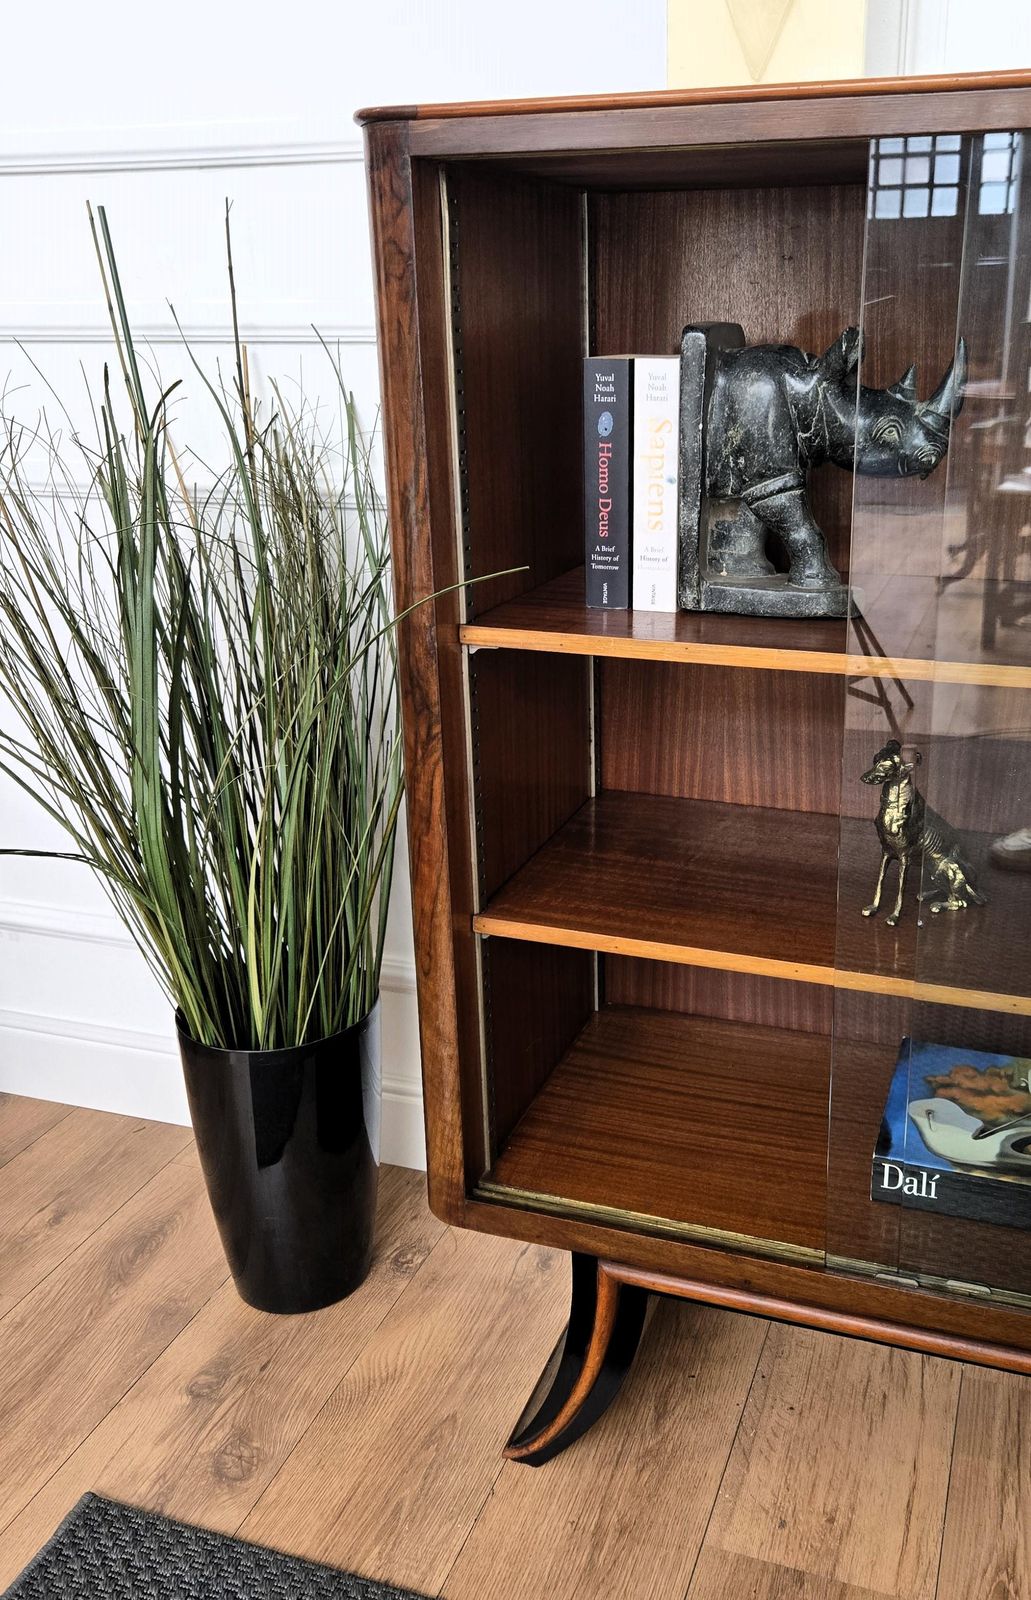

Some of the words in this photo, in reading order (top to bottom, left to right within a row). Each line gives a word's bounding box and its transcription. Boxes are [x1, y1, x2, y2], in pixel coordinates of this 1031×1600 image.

[595, 373, 615, 382] Yuval
[648, 372, 667, 381] Yuval
[595, 384, 615, 392] Noah
[648, 384, 667, 392] Noah
[593, 394, 617, 403] Harari
[598, 442, 612, 494] Homo
[640, 418, 673, 531] Sapiens
[598, 498, 612, 538] Deus
[591, 554, 612, 563] History
[640, 555, 661, 563] History
[591, 563, 619, 571] Tomorrow
[880, 1162, 941, 1200] Dalí
